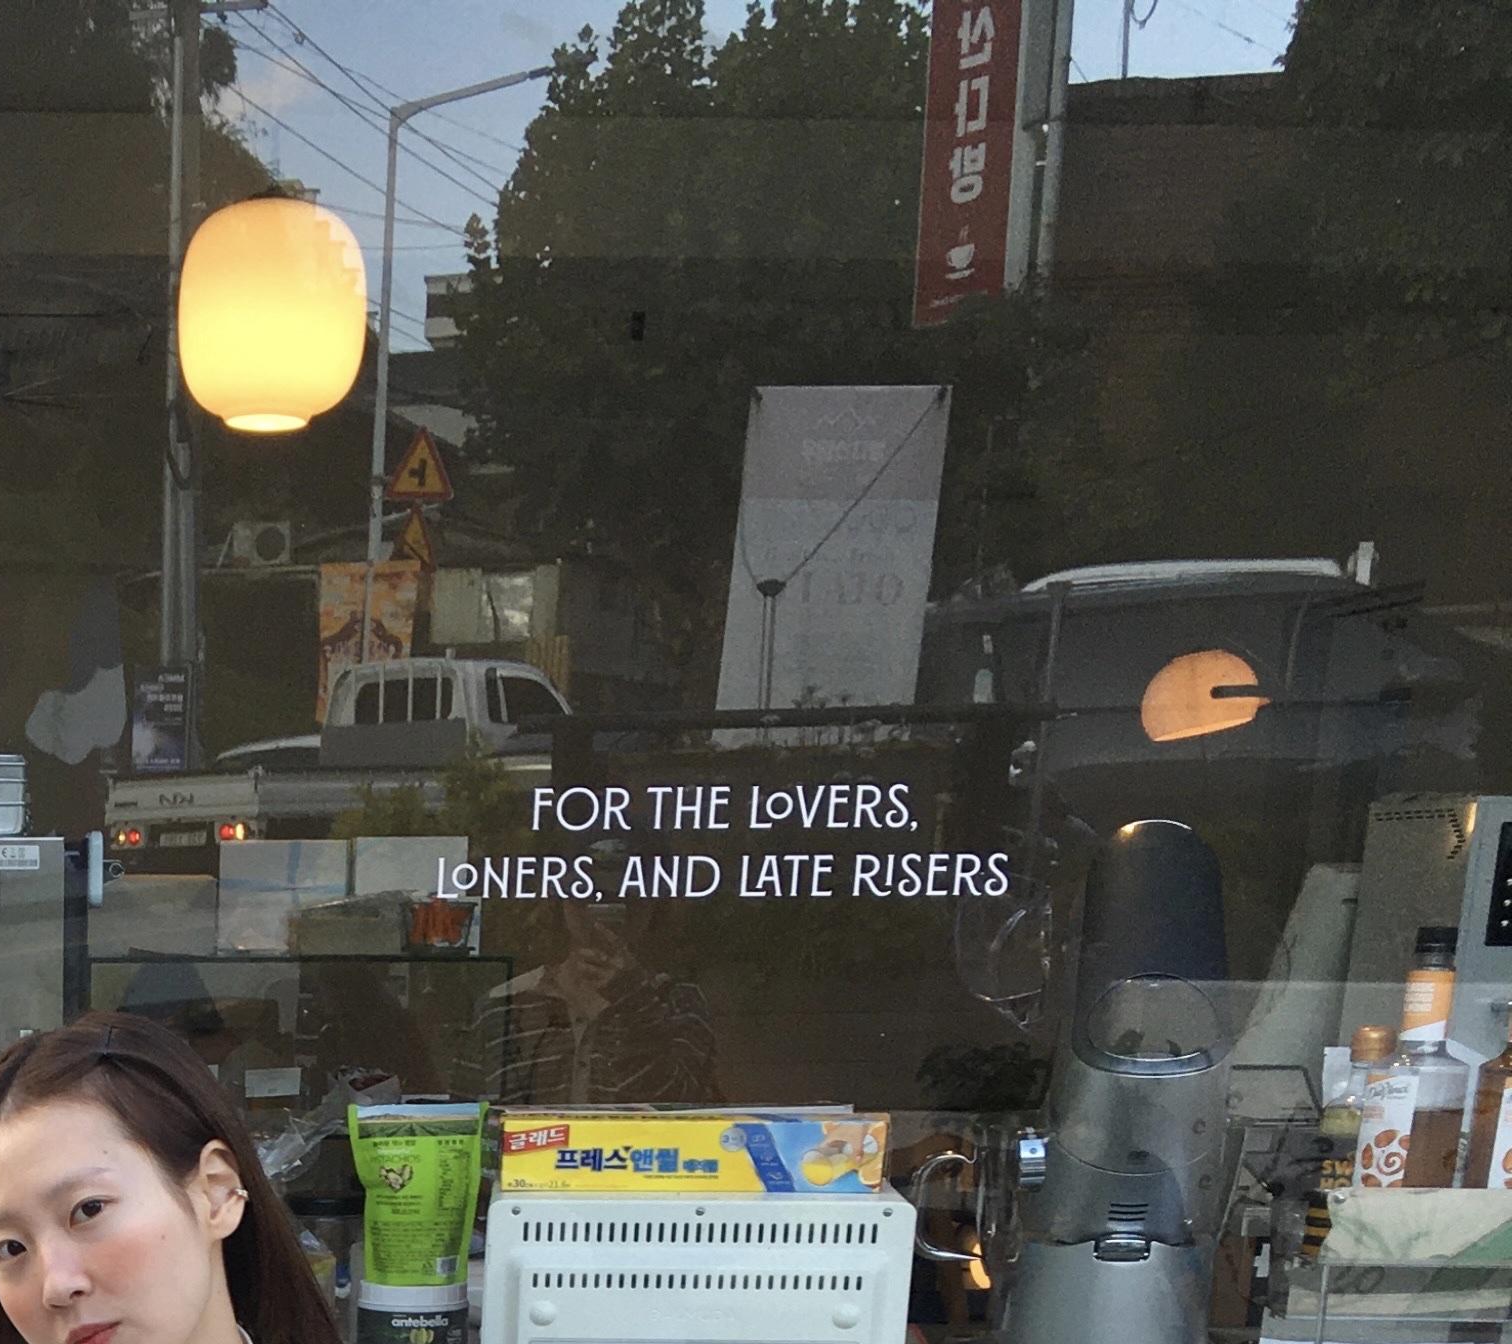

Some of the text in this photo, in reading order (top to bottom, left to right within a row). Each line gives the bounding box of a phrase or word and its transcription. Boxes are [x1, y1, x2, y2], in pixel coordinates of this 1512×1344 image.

[533, 788, 630, 830] FOR
[648, 787, 730, 829] THE
[619, 857, 719, 897] AND
[741, 855, 833, 896] LATE
[509, 1127, 566, 1151] 글래드
[391, 1315, 449, 1328] antebella
